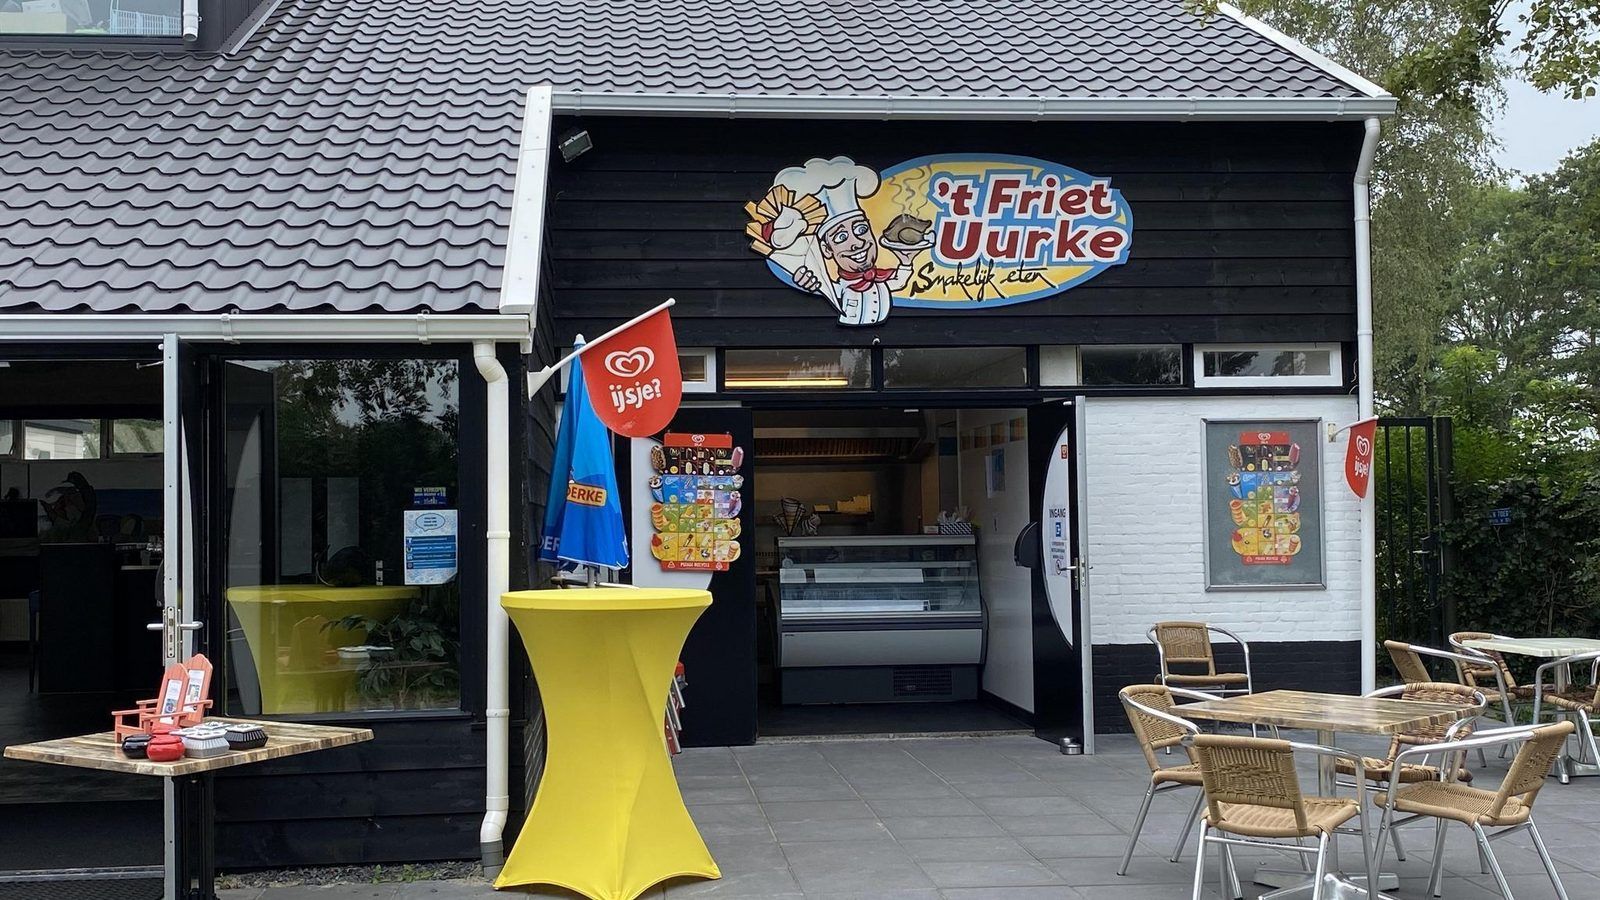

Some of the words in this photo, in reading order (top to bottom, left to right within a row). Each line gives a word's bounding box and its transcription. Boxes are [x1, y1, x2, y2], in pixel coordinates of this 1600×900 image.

[938, 182, 972, 215] 't
[988, 177, 1112, 214] Friet
[940, 219, 1124, 260] Uurke
[909, 257, 1007, 302] Smakelijk
[1000, 260, 1058, 289] eten
[608, 377, 662, 414] ijsje?
